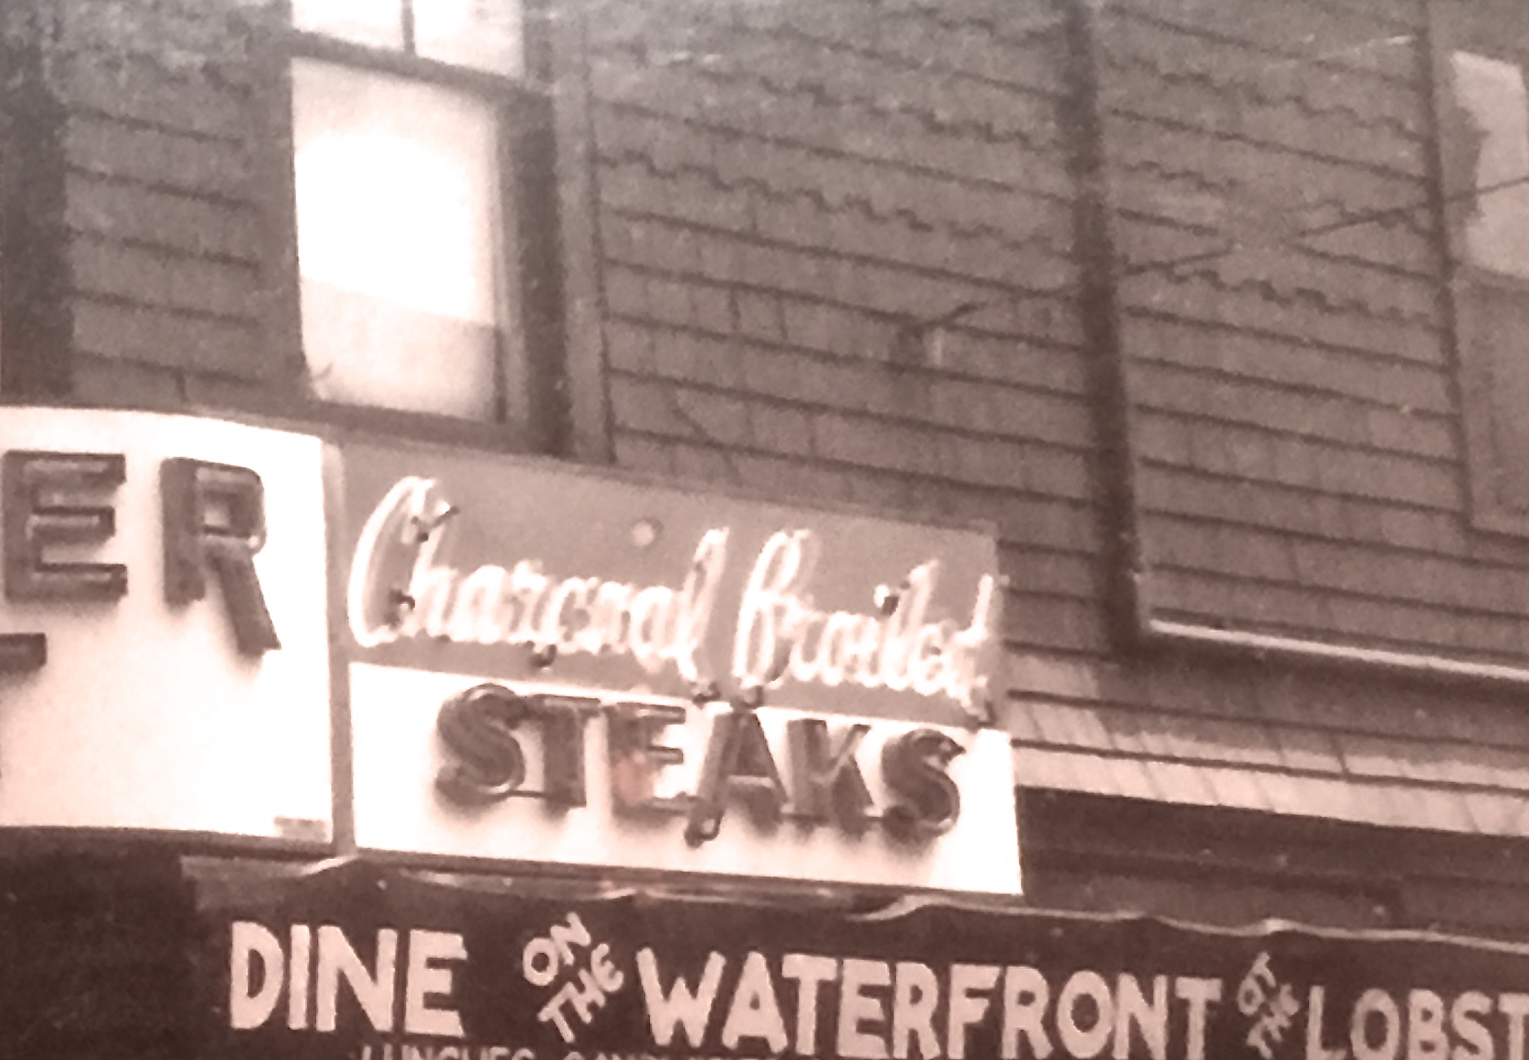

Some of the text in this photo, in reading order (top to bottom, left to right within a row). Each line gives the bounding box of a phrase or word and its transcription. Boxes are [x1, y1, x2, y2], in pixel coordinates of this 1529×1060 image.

[434, 683, 966, 845] STEAKS
[230, 920, 469, 1037] DINE
[521, 911, 592, 987] ON
[538, 942, 625, 1044] THE
[1246, 983, 1301, 1060] THE
